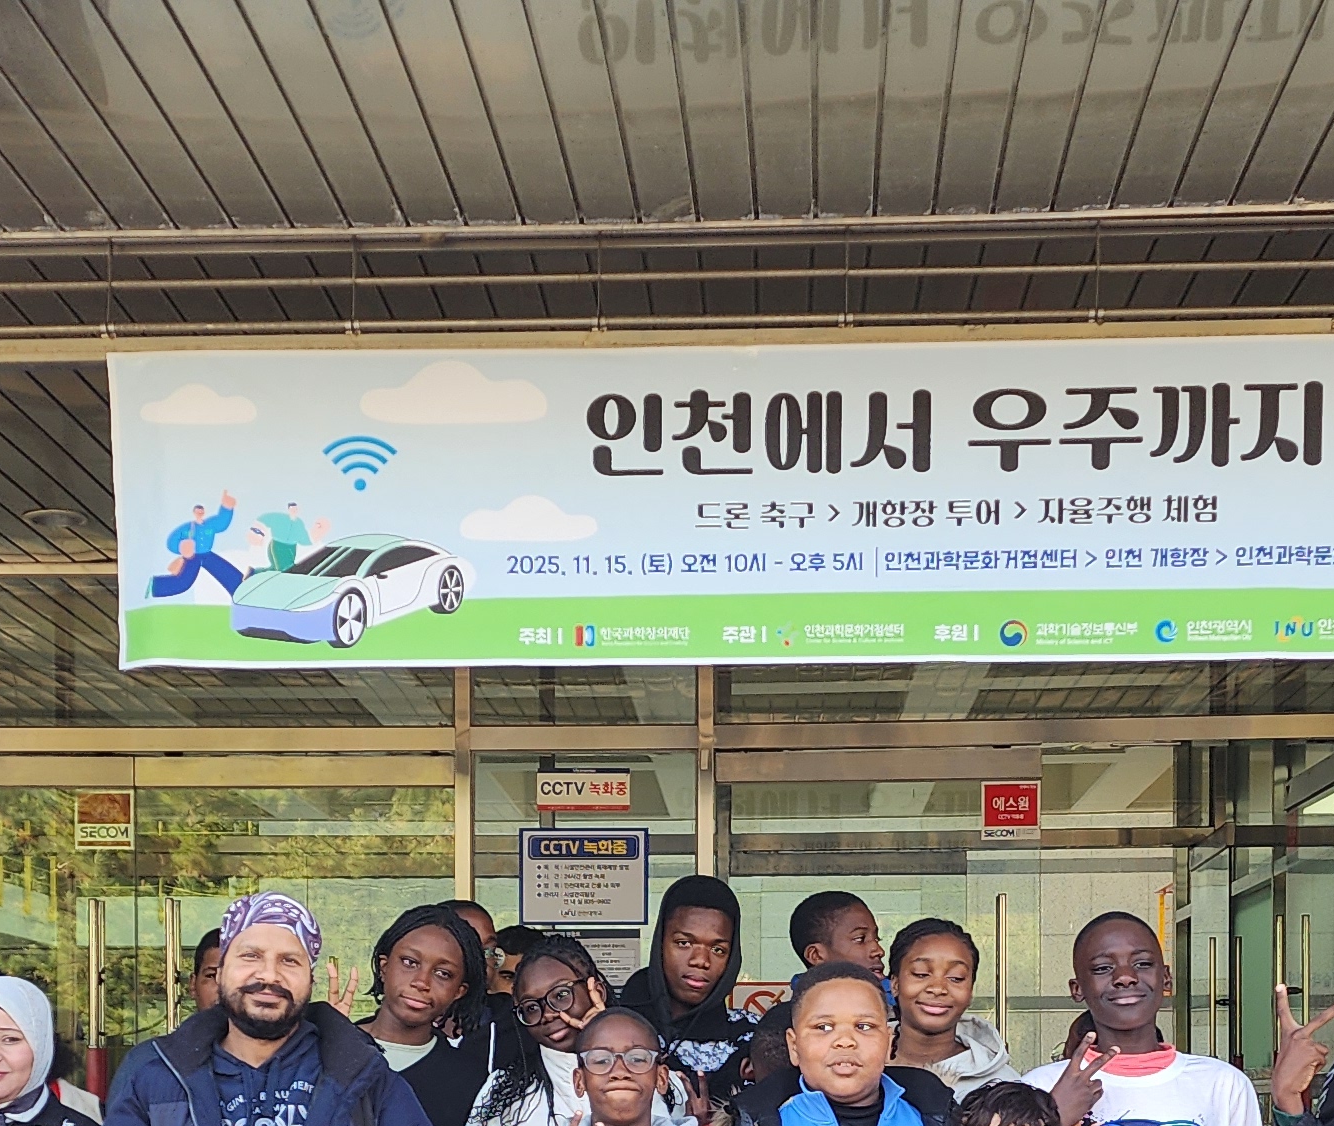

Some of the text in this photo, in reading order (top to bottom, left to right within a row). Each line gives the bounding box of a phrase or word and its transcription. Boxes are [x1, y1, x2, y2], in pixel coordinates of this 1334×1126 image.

[586, 380, 1325, 477] 인천에서 우주까지
[694, 501, 751, 530] 드론
[759, 501, 816, 529] 축구
[851, 499, 939, 528] 개항장
[945, 498, 1002, 527] 투어
[1037, 496, 1153, 525] 자율주행
[1161, 494, 1219, 523] 체험
[506, 555, 567, 576] 2025.
[572, 555, 598, 576] 11.
[604, 555, 633, 576] 15.
[640, 552, 674, 575] (토)
[680, 553, 719, 574] 오전
[723, 552, 767, 573] 10시
[788, 551, 827, 573] 오후
[831, 551, 864, 572] 5시
[884, 548, 1078, 571] 인천과학문화거점센터
[1104, 547, 1144, 569] 인천
[1150, 546, 1210, 568] 개항장
[600, 626, 691, 641] 한국과학창의재단
[722, 625, 757, 644] 주관
[804, 623, 906, 638] 인천과학문화거점센터
[933, 624, 969, 643] 후원
[1035, 622, 1139, 637] 과학기술정보통신부
[1186, 619, 1253, 635] 인천광역시
[518, 626, 553, 646] 주최
[540, 781, 628, 796] CCTV 녹화중
[992, 796, 1030, 812] 에스원
[79, 826, 129, 839] SECOM
[983, 829, 1015, 838] SECOM
[540, 839, 628, 856] CCTV 녹화중
